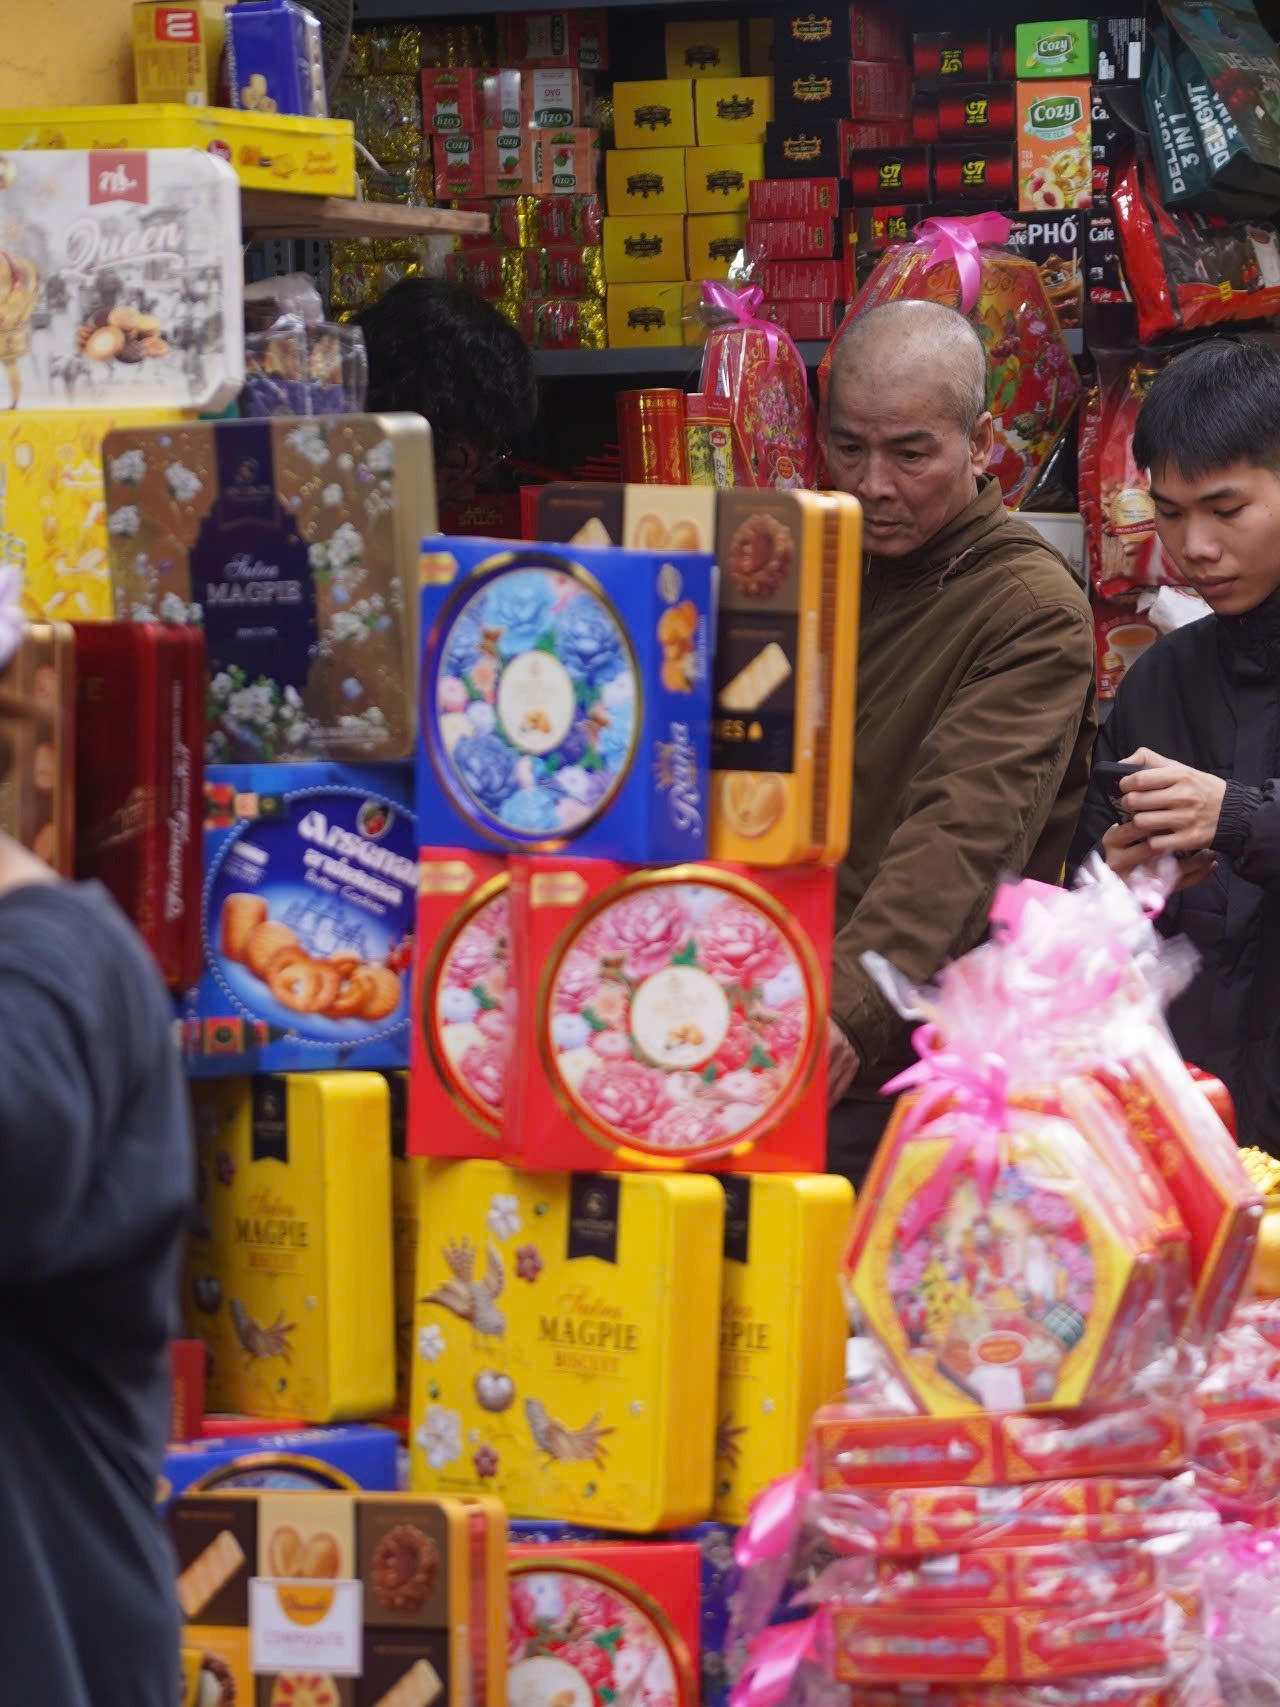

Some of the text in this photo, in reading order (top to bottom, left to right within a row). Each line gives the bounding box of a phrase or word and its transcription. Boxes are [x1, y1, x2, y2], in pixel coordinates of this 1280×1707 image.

[1039, 38, 1068, 53] Cozy
[965, 99, 988, 115] G7
[1033, 101, 1076, 122] Cozy
[1187, 82, 1230, 169] DELIGHT
[1173, 125, 1195, 151] IN
[879, 163, 902, 179] G7
[963, 160, 986, 176] G7
[1181, 152, 1200, 168] 3
[1008, 214, 1078, 245] afé PHỐ
[1089, 227, 1115, 242] Café
[62, 217, 187, 273] Queen
[206, 580, 302, 606] MAGPIE
[235, 1218, 310, 1248] MAGPIE
[538, 1316, 641, 1351] MAGPIE
